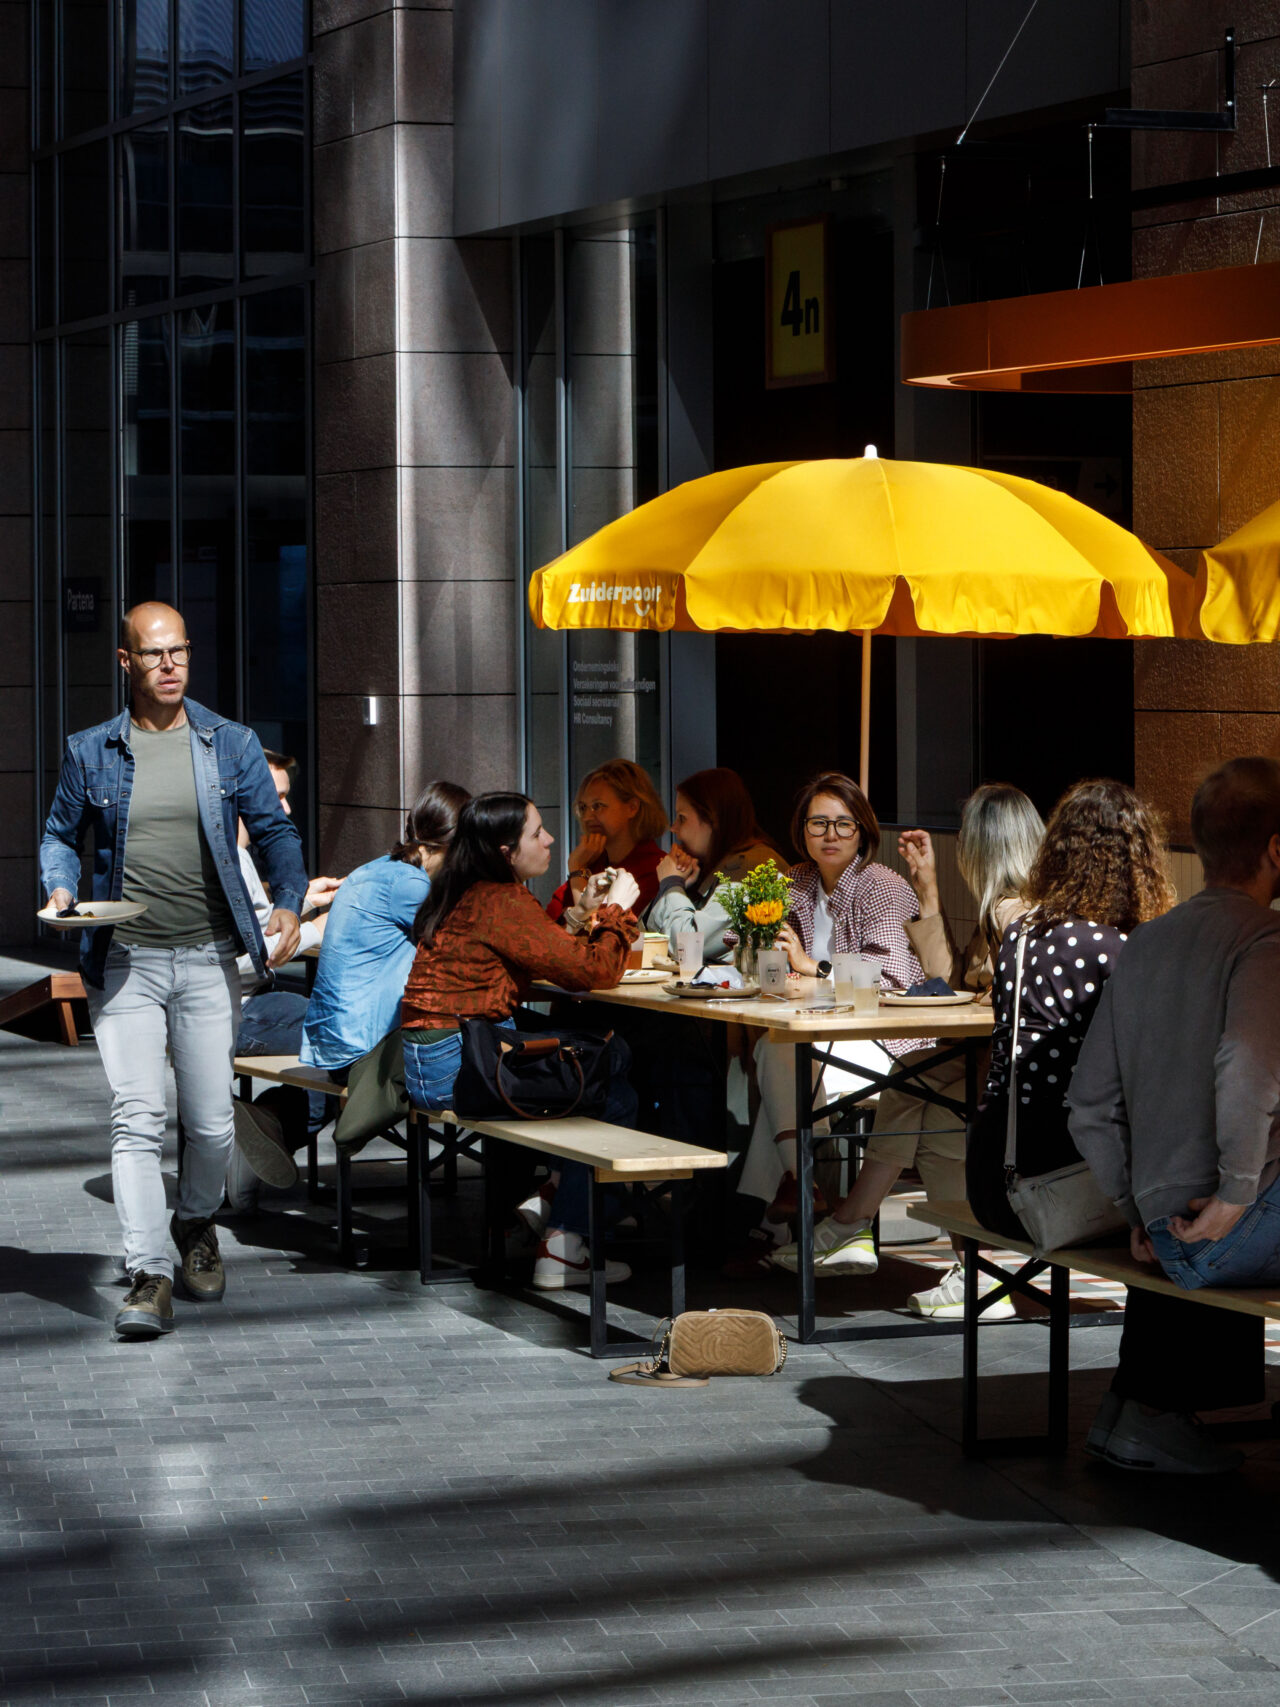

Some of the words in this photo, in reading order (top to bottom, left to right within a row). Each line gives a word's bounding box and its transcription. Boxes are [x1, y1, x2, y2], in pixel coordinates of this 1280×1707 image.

[780, 270, 819, 337] 4n
[67, 588, 95, 611] Partena
[567, 581, 662, 605] Zuiderpoort
